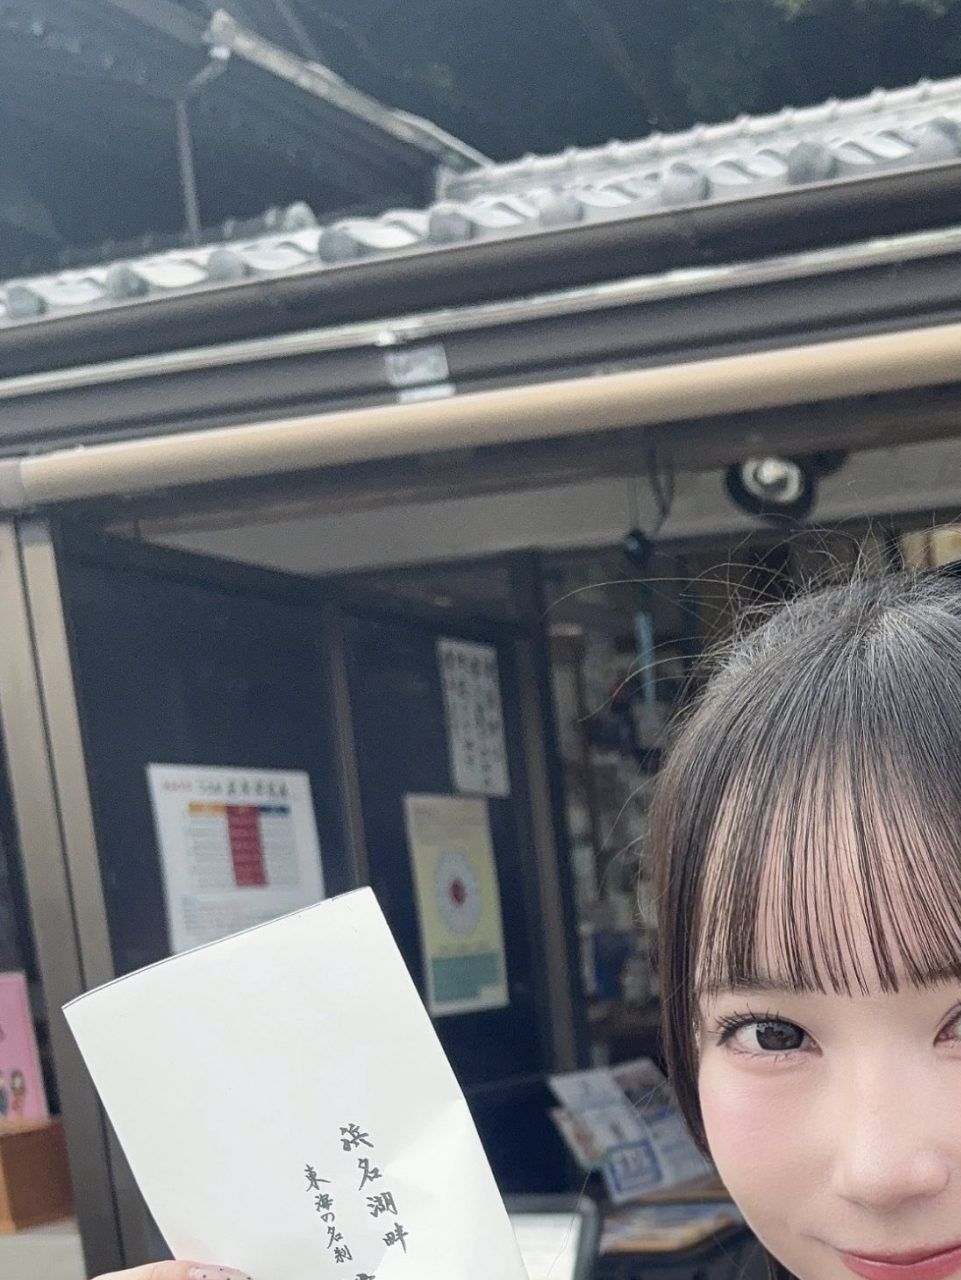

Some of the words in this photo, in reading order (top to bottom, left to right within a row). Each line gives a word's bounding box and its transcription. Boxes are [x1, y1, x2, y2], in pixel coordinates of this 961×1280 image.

[304, 1164, 353, 1264] 東海の名刹
[339, 1123, 409, 1254] 浜名湖畔
